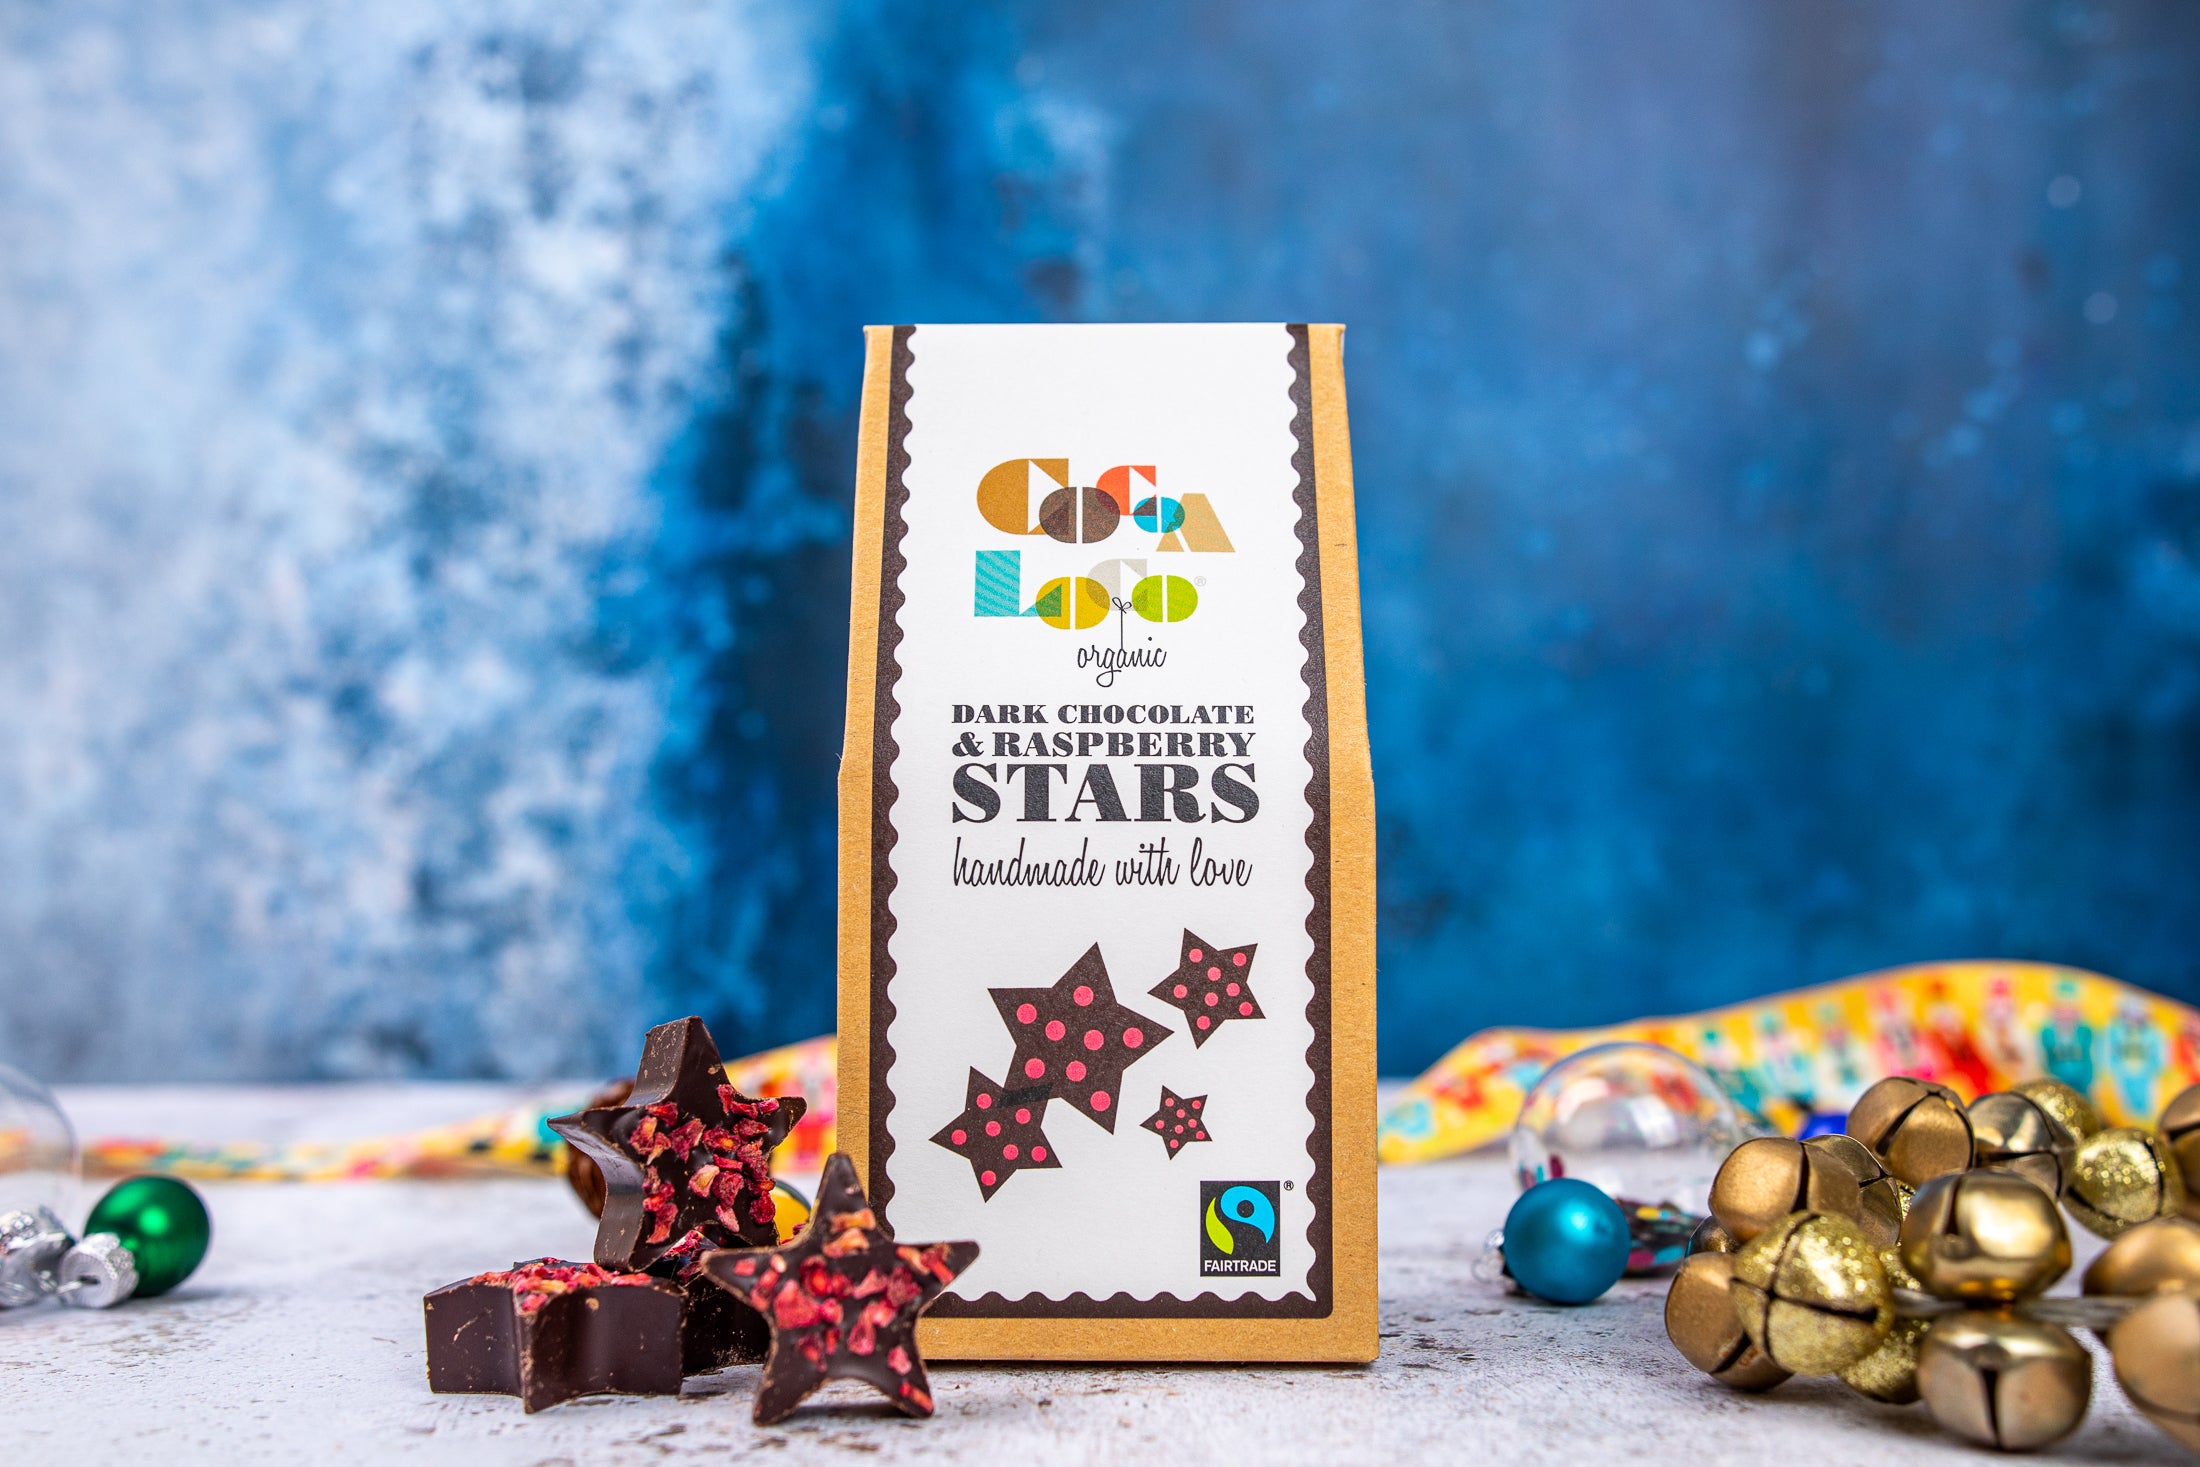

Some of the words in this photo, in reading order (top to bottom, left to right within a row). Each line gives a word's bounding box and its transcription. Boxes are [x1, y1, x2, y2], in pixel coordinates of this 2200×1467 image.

[1077, 636, 1167, 688] organic
[951, 704, 1049, 724] DARK
[1057, 704, 1255, 725] CHOCOLATE
[951, 731, 985, 757] &
[991, 731, 1257, 758] RASPBERRY
[952, 762, 1260, 824] STARS
[953, 836, 1106, 887] handmade
[1115, 836, 1181, 887] with
[1190, 836, 1253, 887] love
[1204, 1260, 1277, 1272] FAIRTRADE
